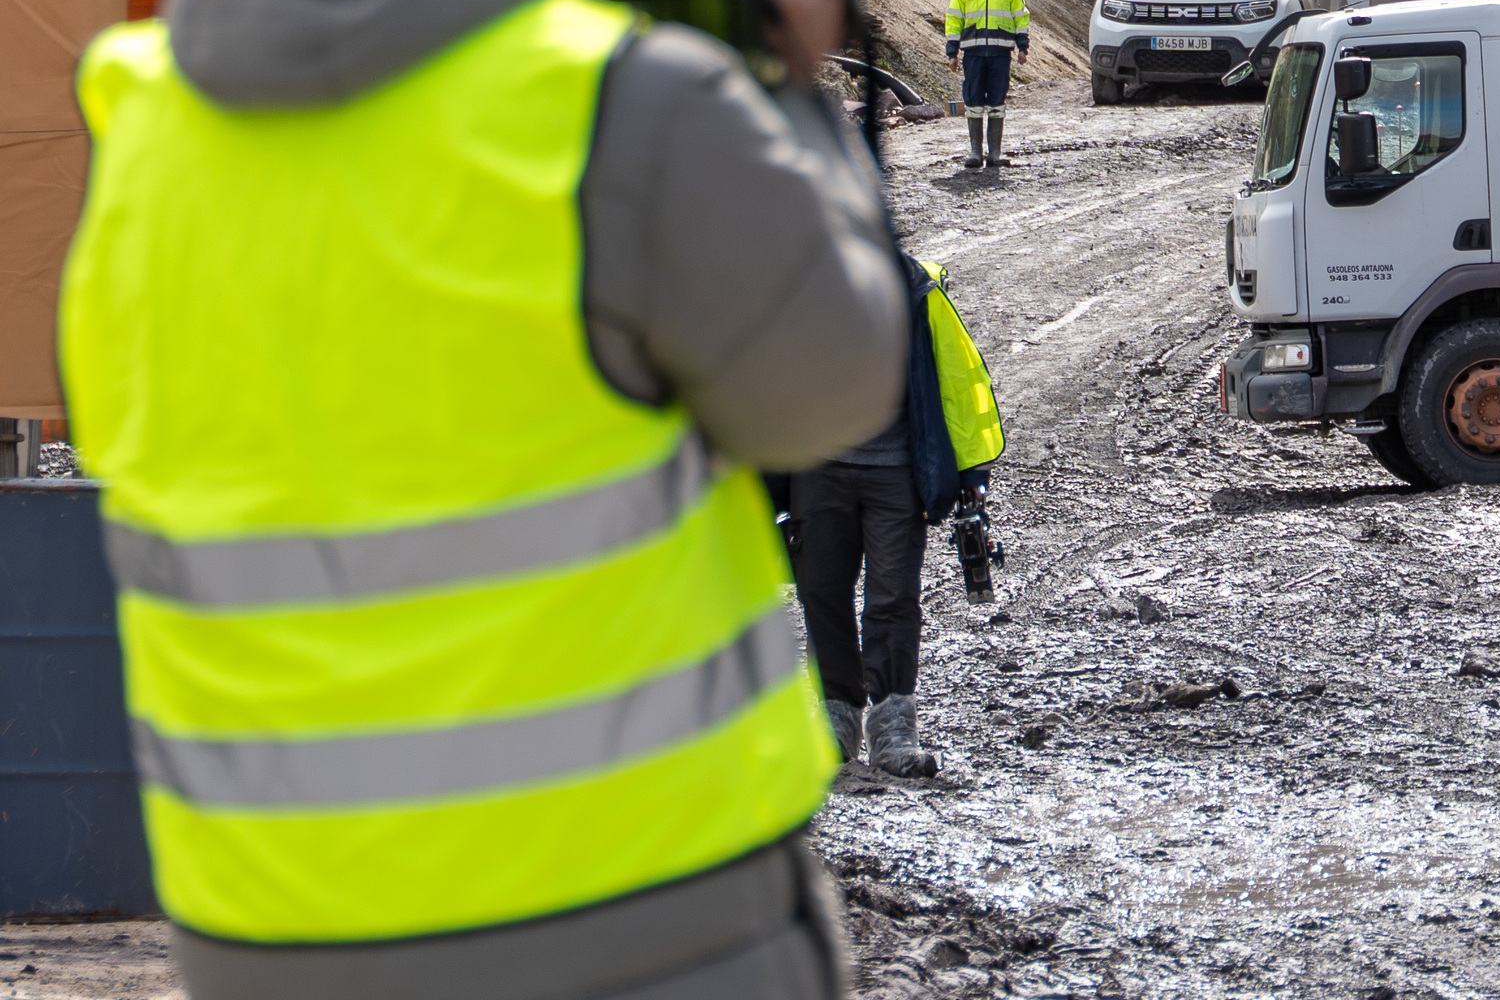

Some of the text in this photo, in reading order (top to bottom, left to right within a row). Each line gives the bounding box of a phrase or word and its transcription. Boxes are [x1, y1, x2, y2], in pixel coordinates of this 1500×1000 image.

[1158, 38, 1208, 49] 8458 MJB
[1326, 264, 1394, 274] GASOLEOS ARTAJONA
[1329, 274, 1349, 282] 948
[1322, 296, 1344, 304] 240
